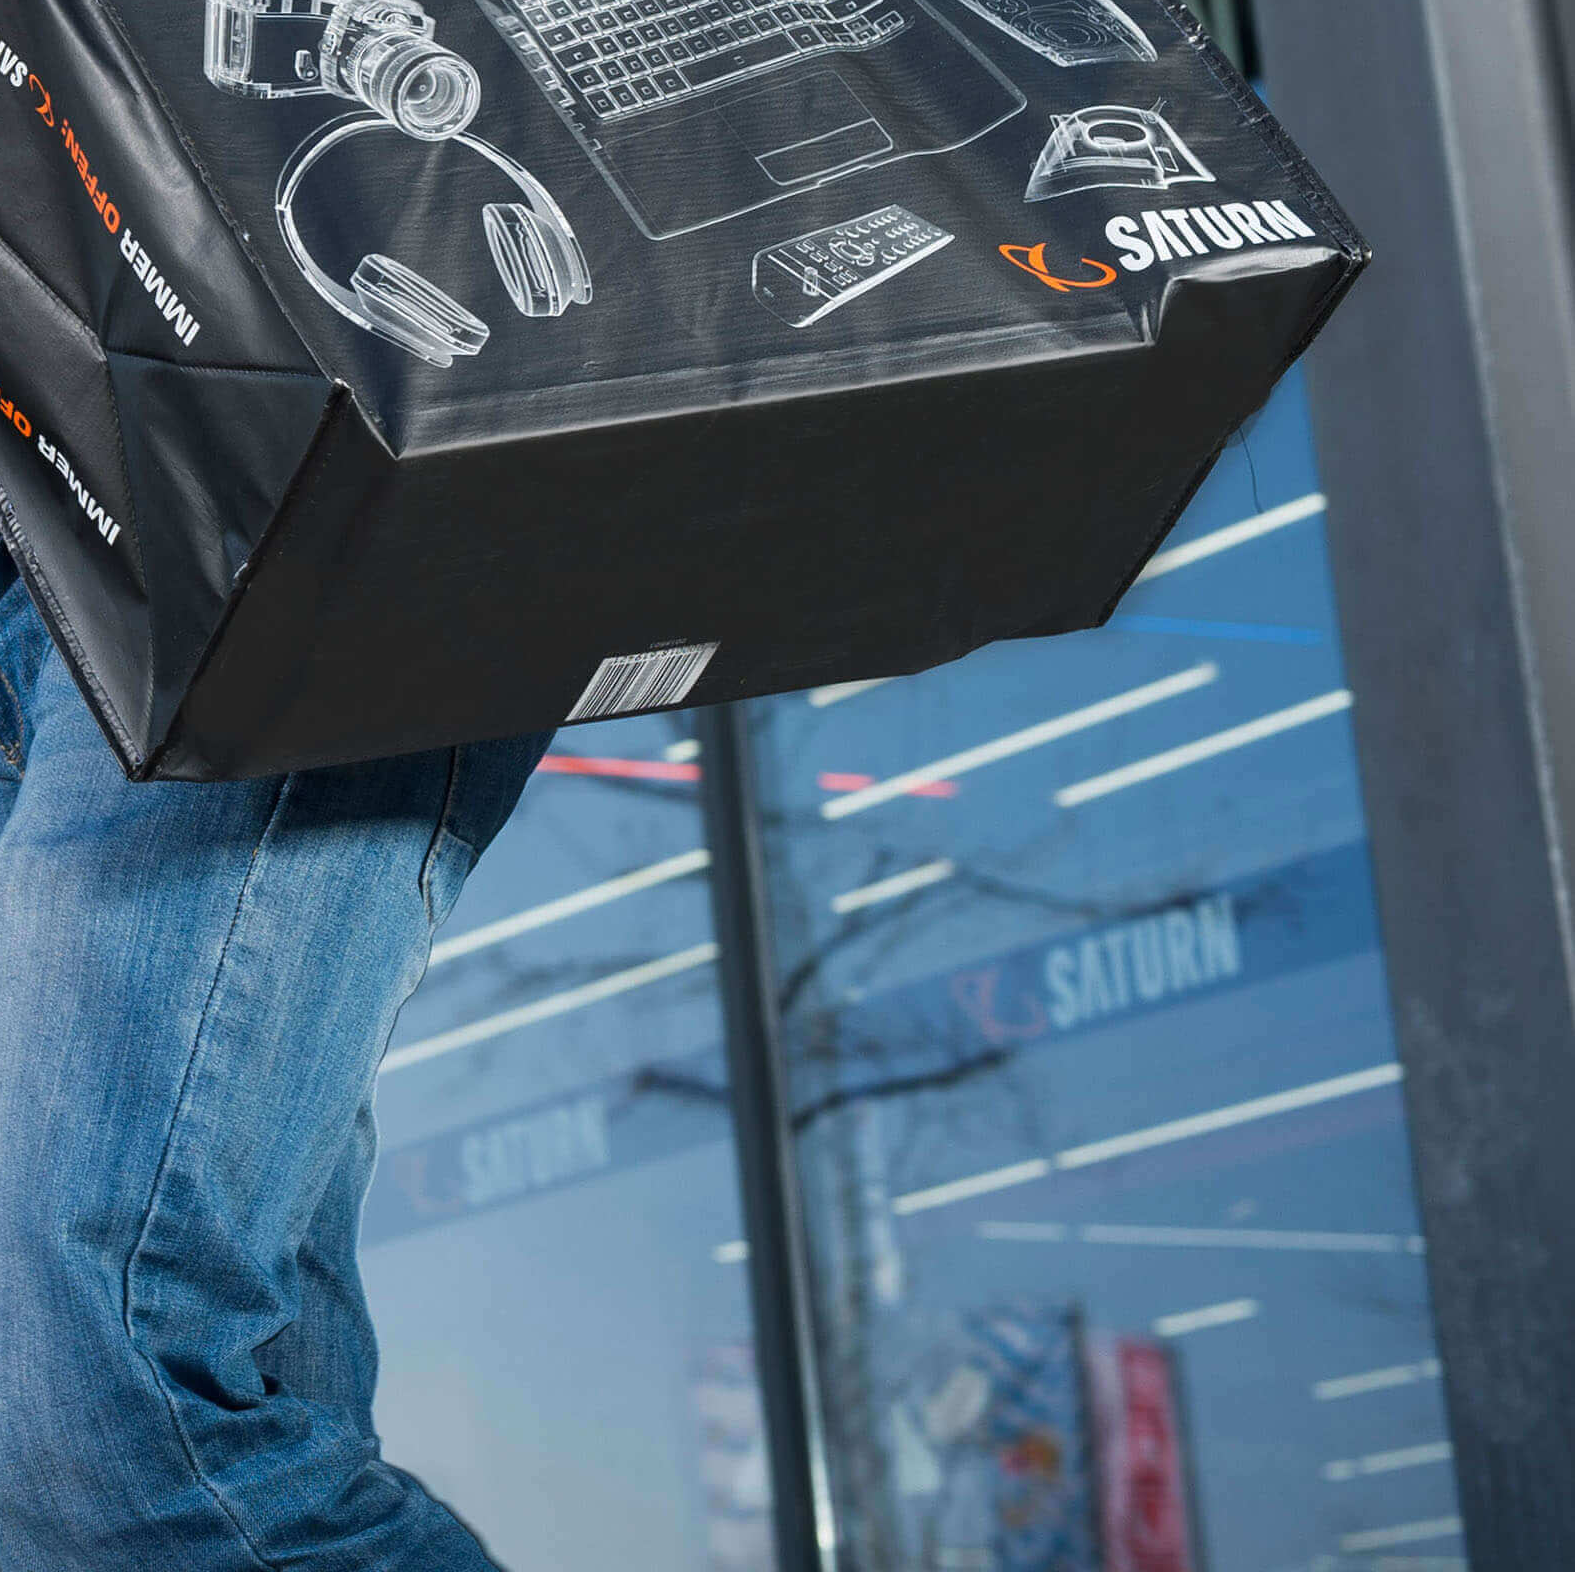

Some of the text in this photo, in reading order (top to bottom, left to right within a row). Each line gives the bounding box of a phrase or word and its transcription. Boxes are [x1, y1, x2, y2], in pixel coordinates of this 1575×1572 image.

[61, 118, 121, 234] OFFEN:
[119, 228, 201, 347] IMMER
[1105, 199, 1316, 272] SATURN
[38, 433, 122, 547] IMMER
[1046, 891, 1240, 1030] SATURN
